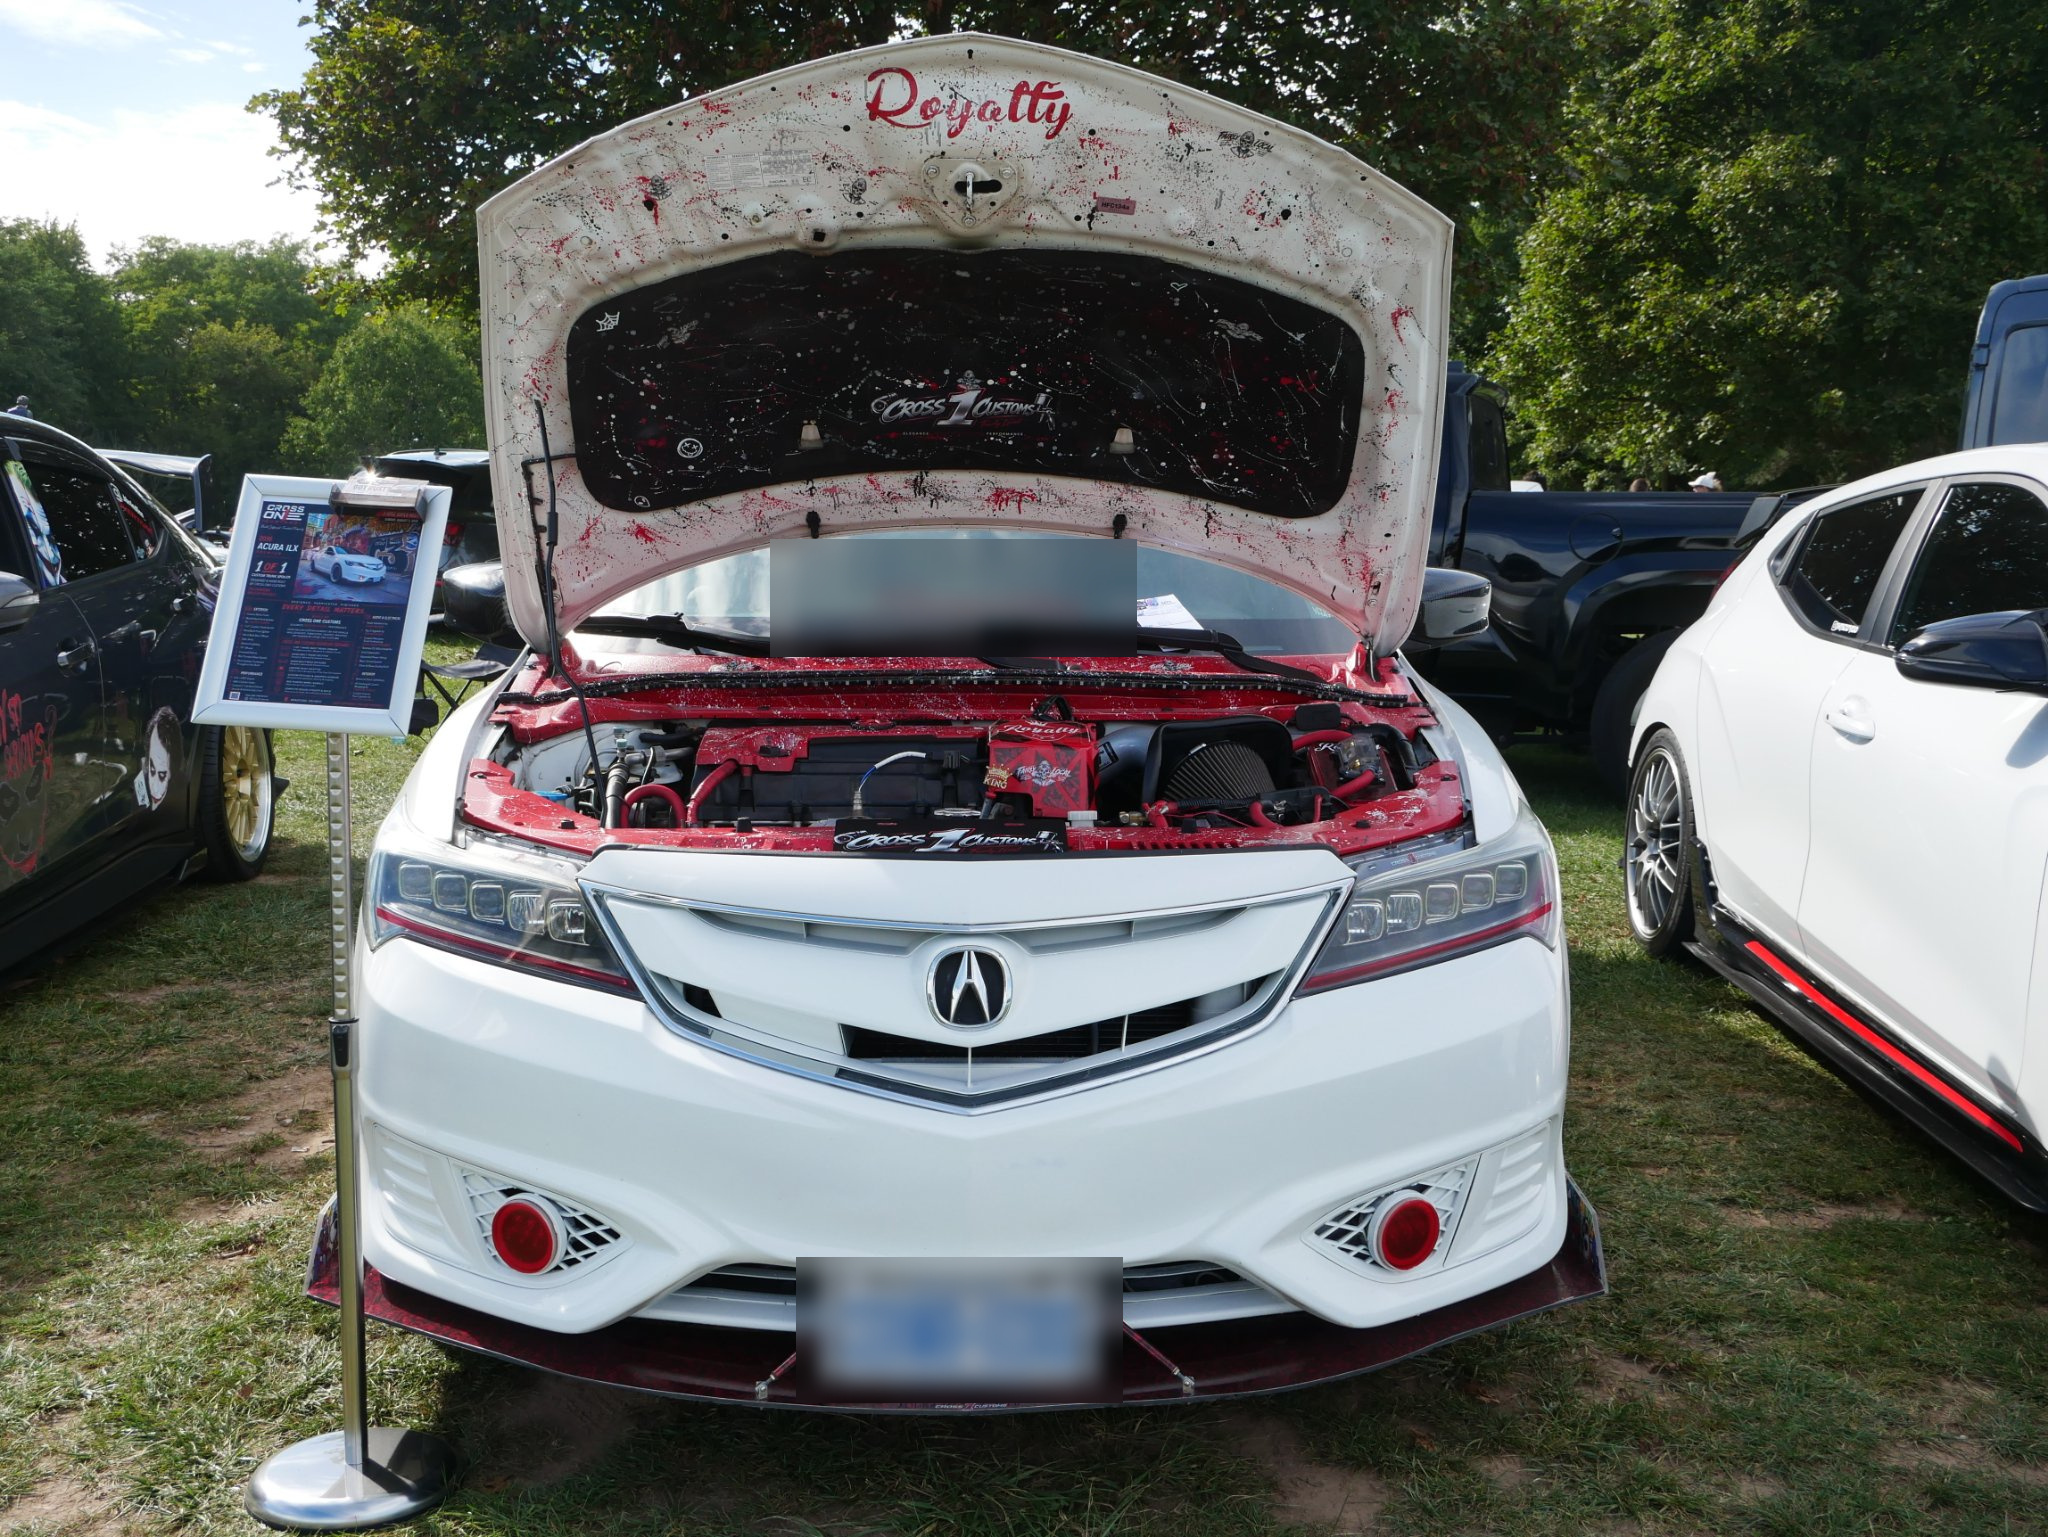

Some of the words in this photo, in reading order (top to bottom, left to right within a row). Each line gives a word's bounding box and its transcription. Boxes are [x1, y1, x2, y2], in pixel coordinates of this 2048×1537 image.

[866, 67, 1073, 140] Royalty
[881, 398, 946, 424] CROSS
[936, 389, 983, 426] 1
[972, 396, 1037, 418] CUSTOMS
[267, 504, 305, 513] CROSS
[257, 543, 284, 552] ACURA
[285, 544, 299, 552] ILX
[255, 560, 264, 572] 1
[279, 562, 288, 574] 1
[1004, 724, 1079, 734] Royalty
[983, 779, 1008, 789] KING
[847, 833, 926, 850] CROSS
[915, 827, 972, 852] 1
[959, 833, 1038, 847] CUSTOMS
